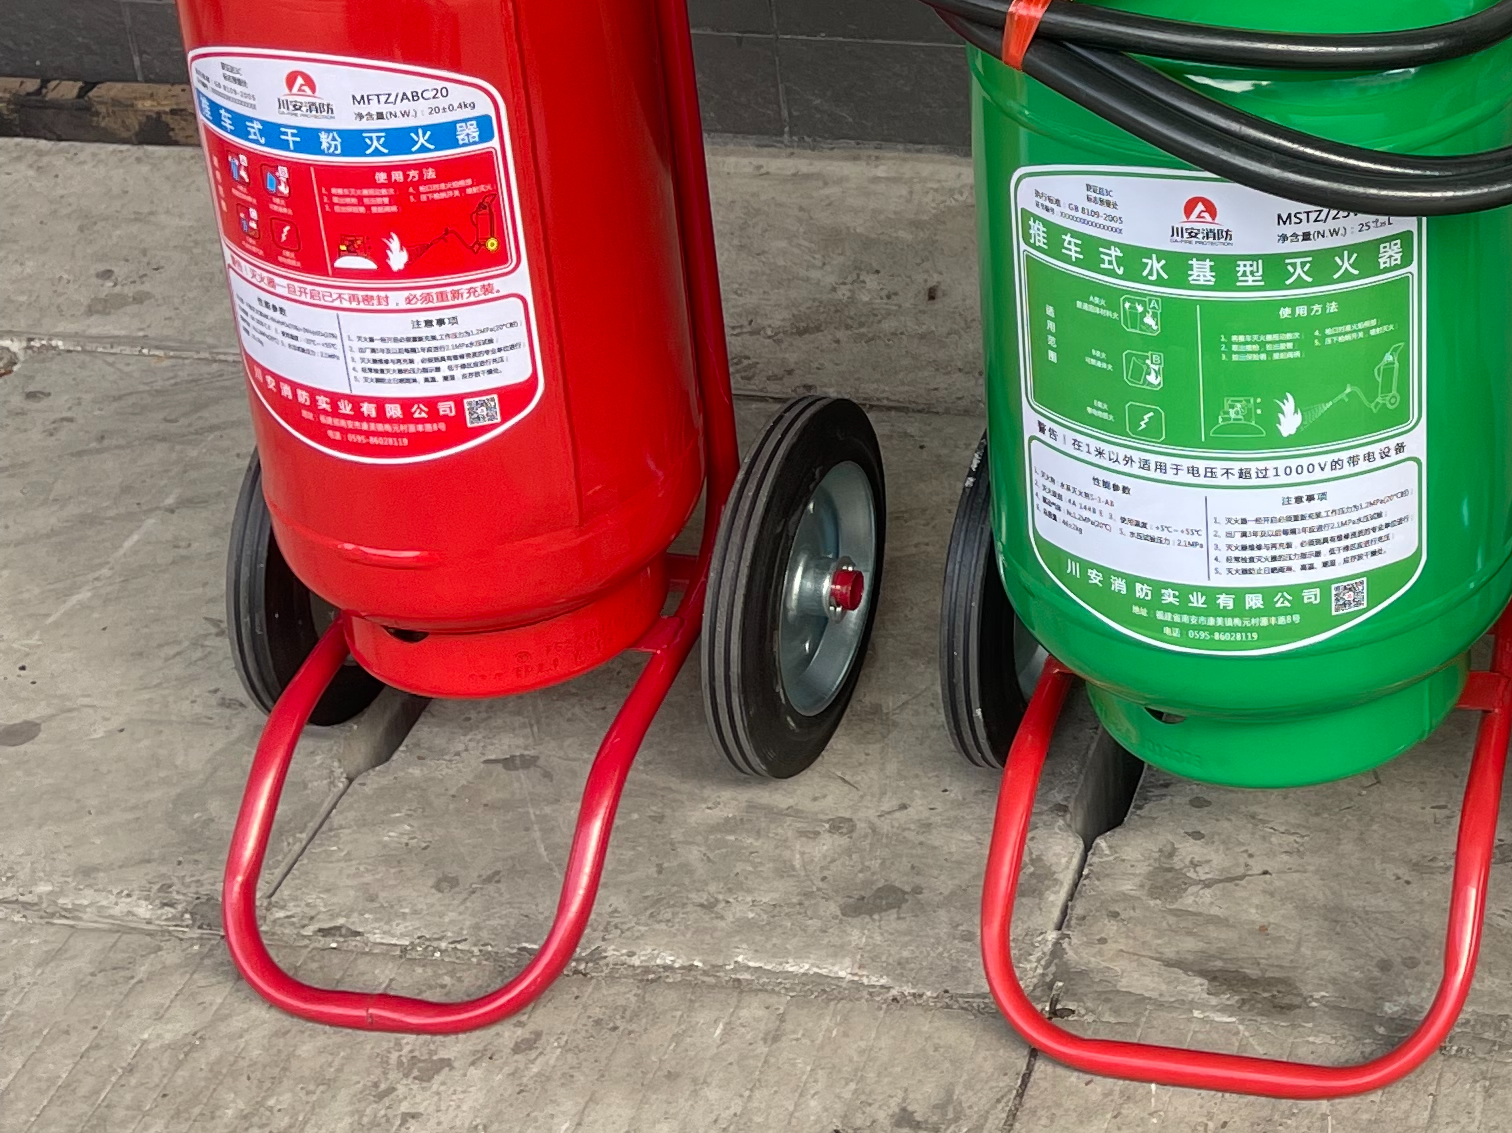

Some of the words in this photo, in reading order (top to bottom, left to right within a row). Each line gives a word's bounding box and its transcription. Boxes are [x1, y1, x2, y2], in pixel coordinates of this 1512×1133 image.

[351, 86, 449, 106] MFTZ/ABC20
[277, 98, 335, 115] 川安消防
[375, 167, 437, 184] 使用方法
[1170, 225, 1233, 242] 川安消防
[1028, 216, 1403, 286] 推车式水基型灭火器
[1279, 301, 1339, 319] 使用方法
[254, 366, 456, 419] 川安消防实业有限公司
[1066, 559, 1321, 609] 川安消防实业有限公司
